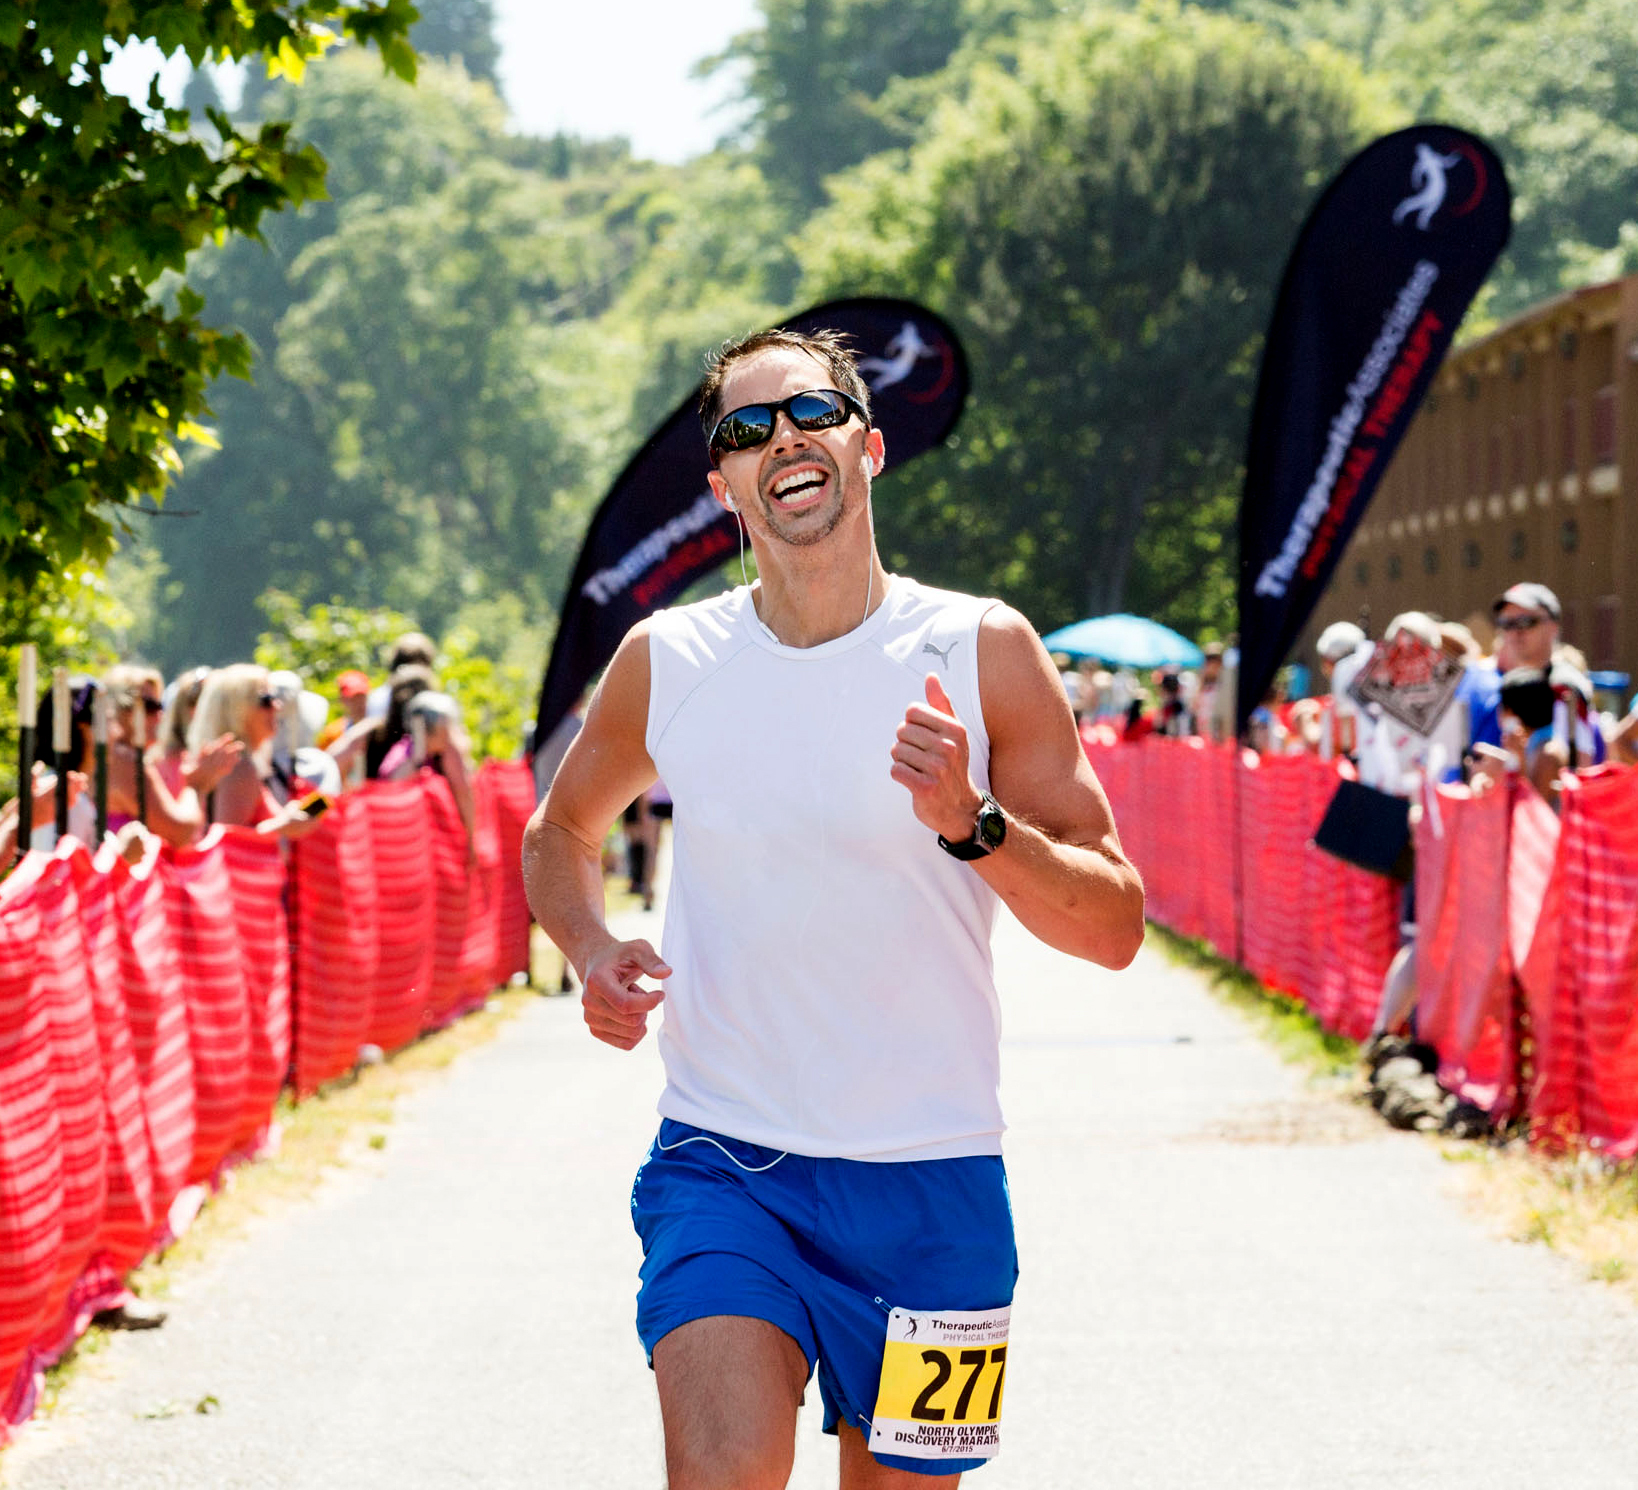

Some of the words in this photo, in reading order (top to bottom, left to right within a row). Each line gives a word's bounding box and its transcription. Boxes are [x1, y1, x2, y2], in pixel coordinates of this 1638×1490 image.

[943, 1333, 985, 1342] PHYSICAL
[918, 1425, 954, 1436] NORTH
[957, 1424, 998, 1436] OLYMPIC
[895, 1431, 957, 1446] DISCOVERY
